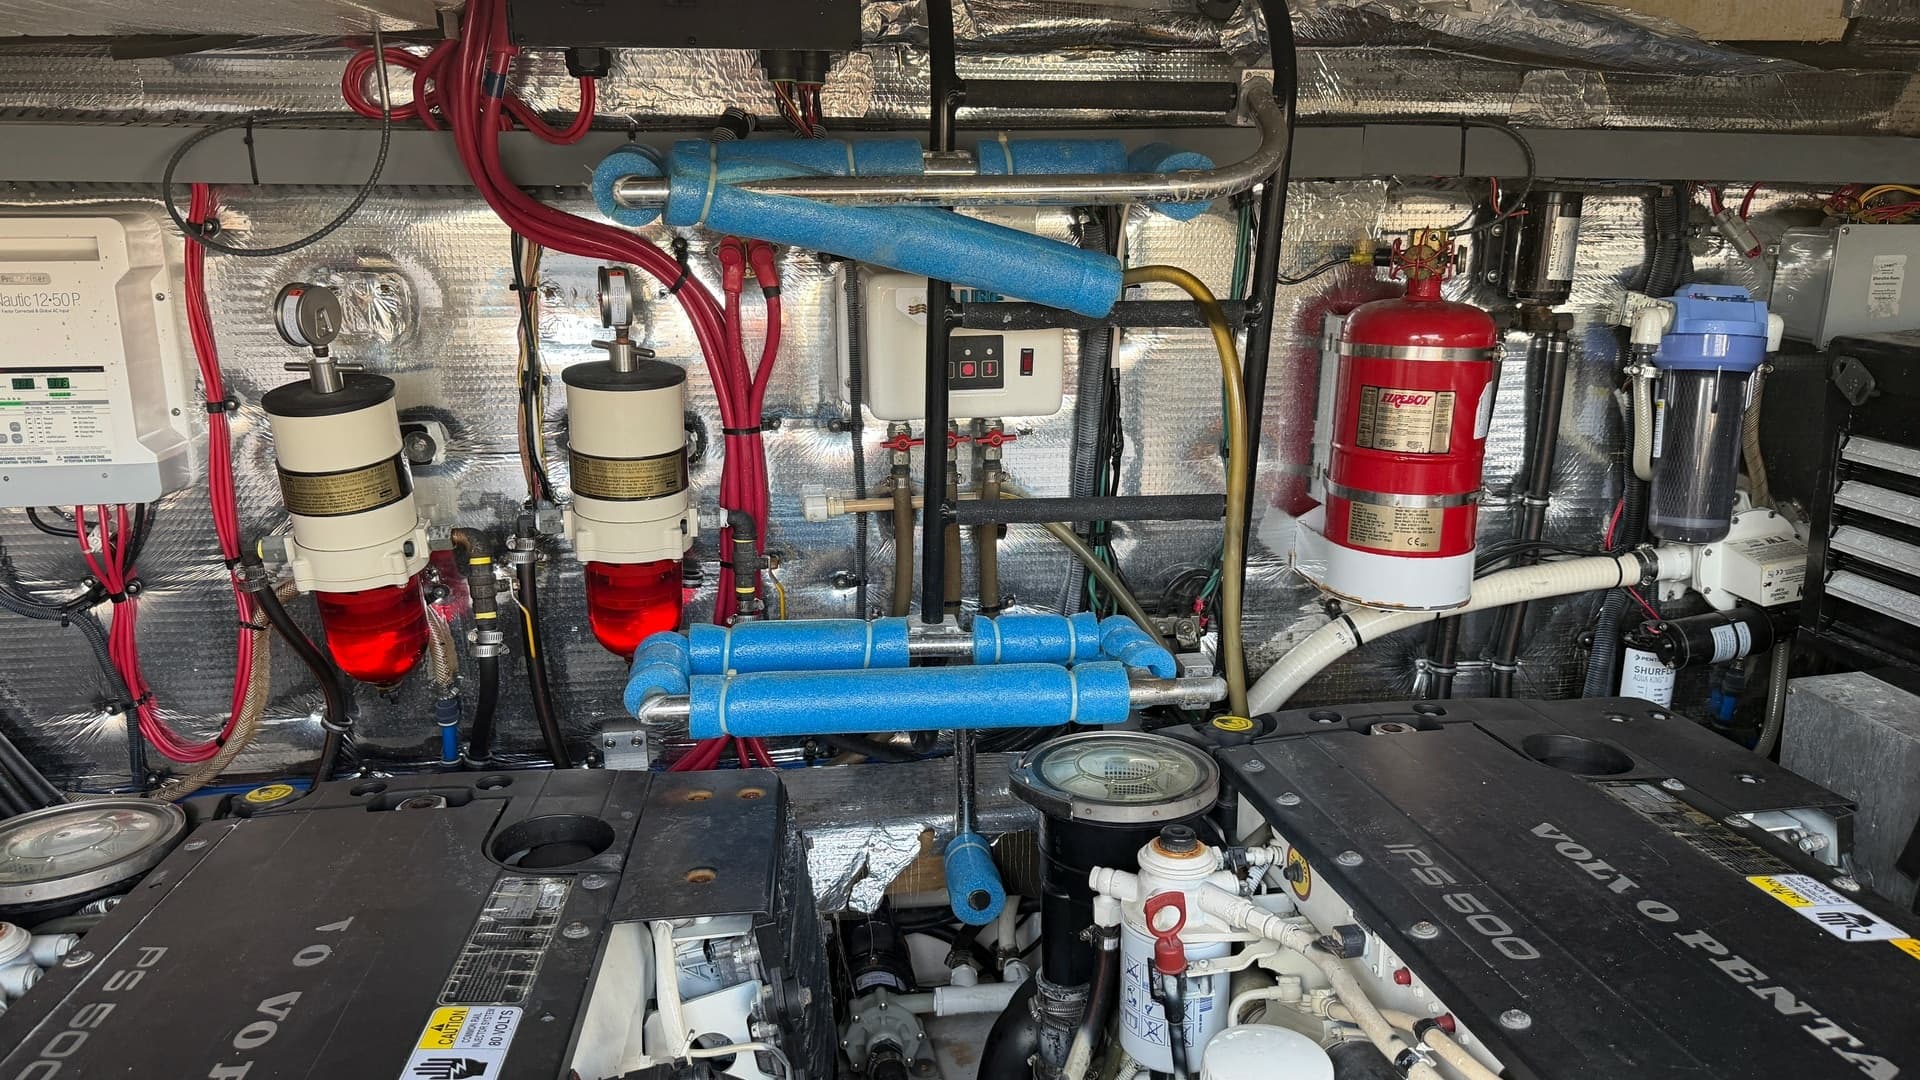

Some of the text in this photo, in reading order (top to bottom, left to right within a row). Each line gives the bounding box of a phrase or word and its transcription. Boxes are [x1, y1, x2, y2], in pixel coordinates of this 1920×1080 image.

[1381, 393, 1432, 408] FIREBOY
[1384, 843, 1541, 960] IPS 500
[1760, 877, 1811, 904] CAUTION
[1530, 822, 1901, 1080] VOLVO PENTA
[438, 1009, 467, 1045] CAUTION
[488, 1009, 515, 1047] 80 VOLTS
